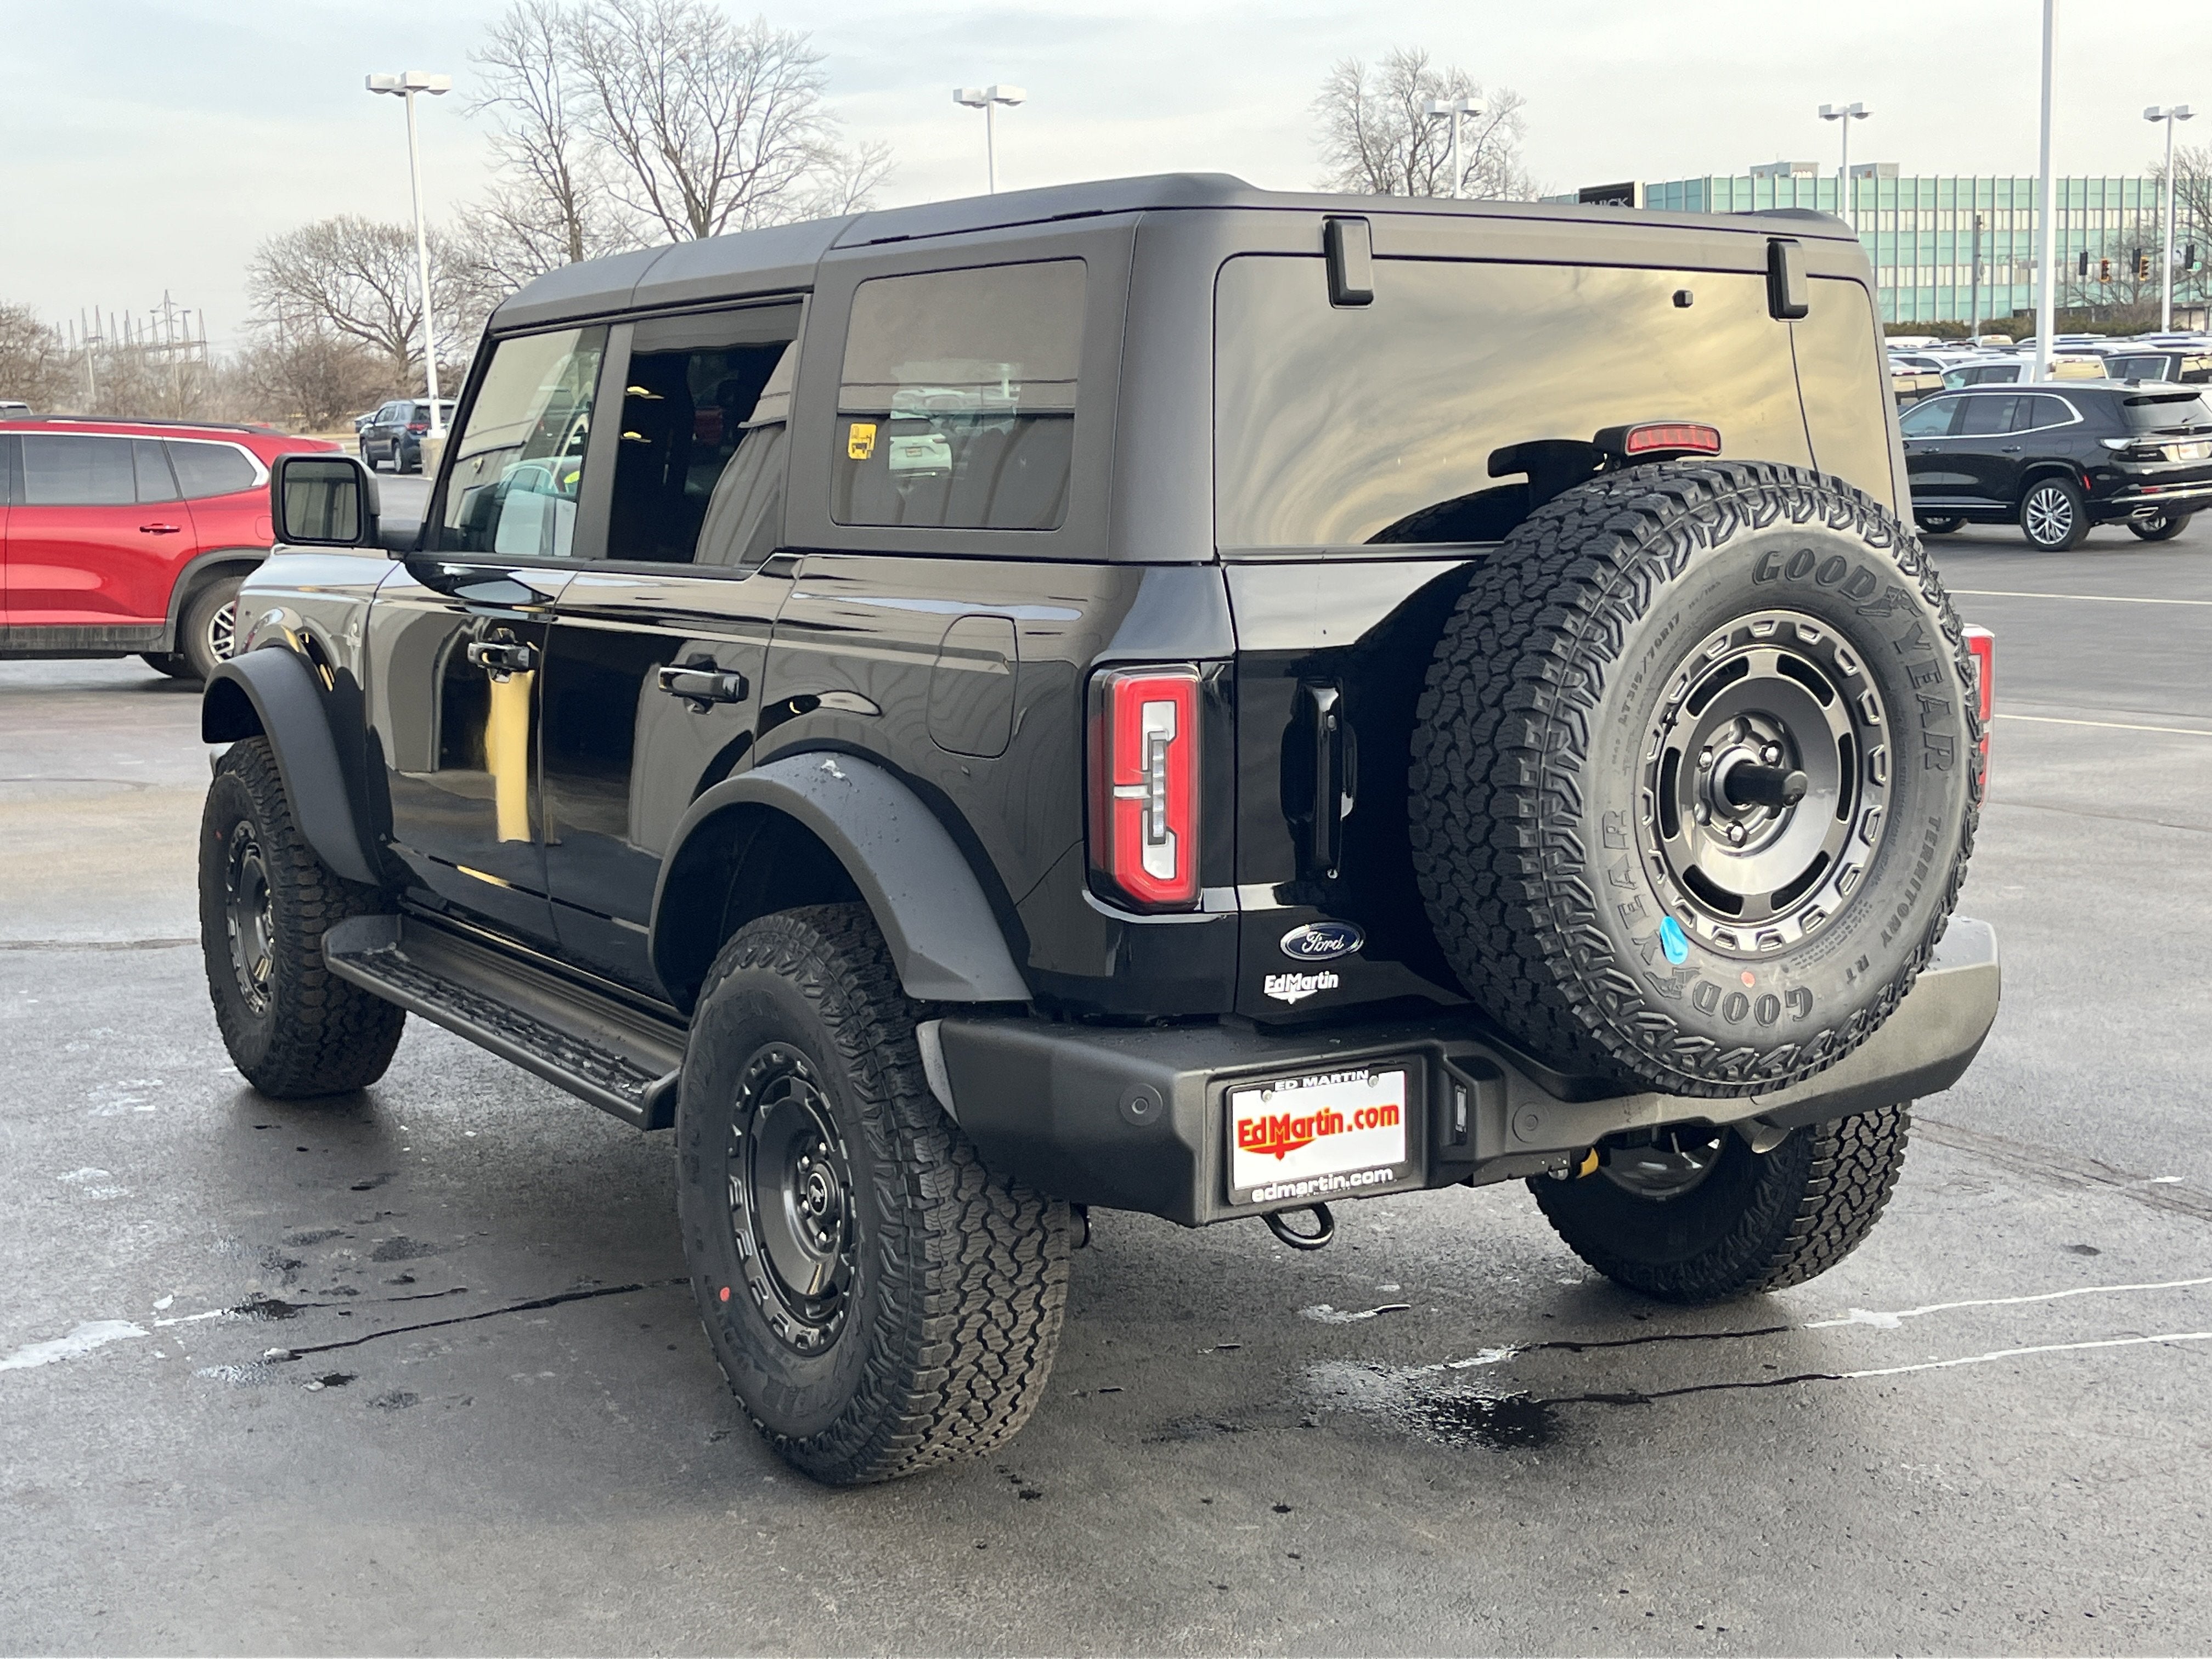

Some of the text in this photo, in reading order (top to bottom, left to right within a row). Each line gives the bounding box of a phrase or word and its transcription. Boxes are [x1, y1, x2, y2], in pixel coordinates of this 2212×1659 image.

[1880, 816, 1942, 948] TERRITORY
[1301, 931, 1344, 953] Ford
[1264, 970, 1339, 994] EdMartin
[1846, 954, 1870, 985] RT
[1274, 1070, 1368, 1092] ED MARTIN
[1238, 1104, 1399, 1148] EdMartin.com
[1251, 1168, 1393, 1202] edmartin.com
